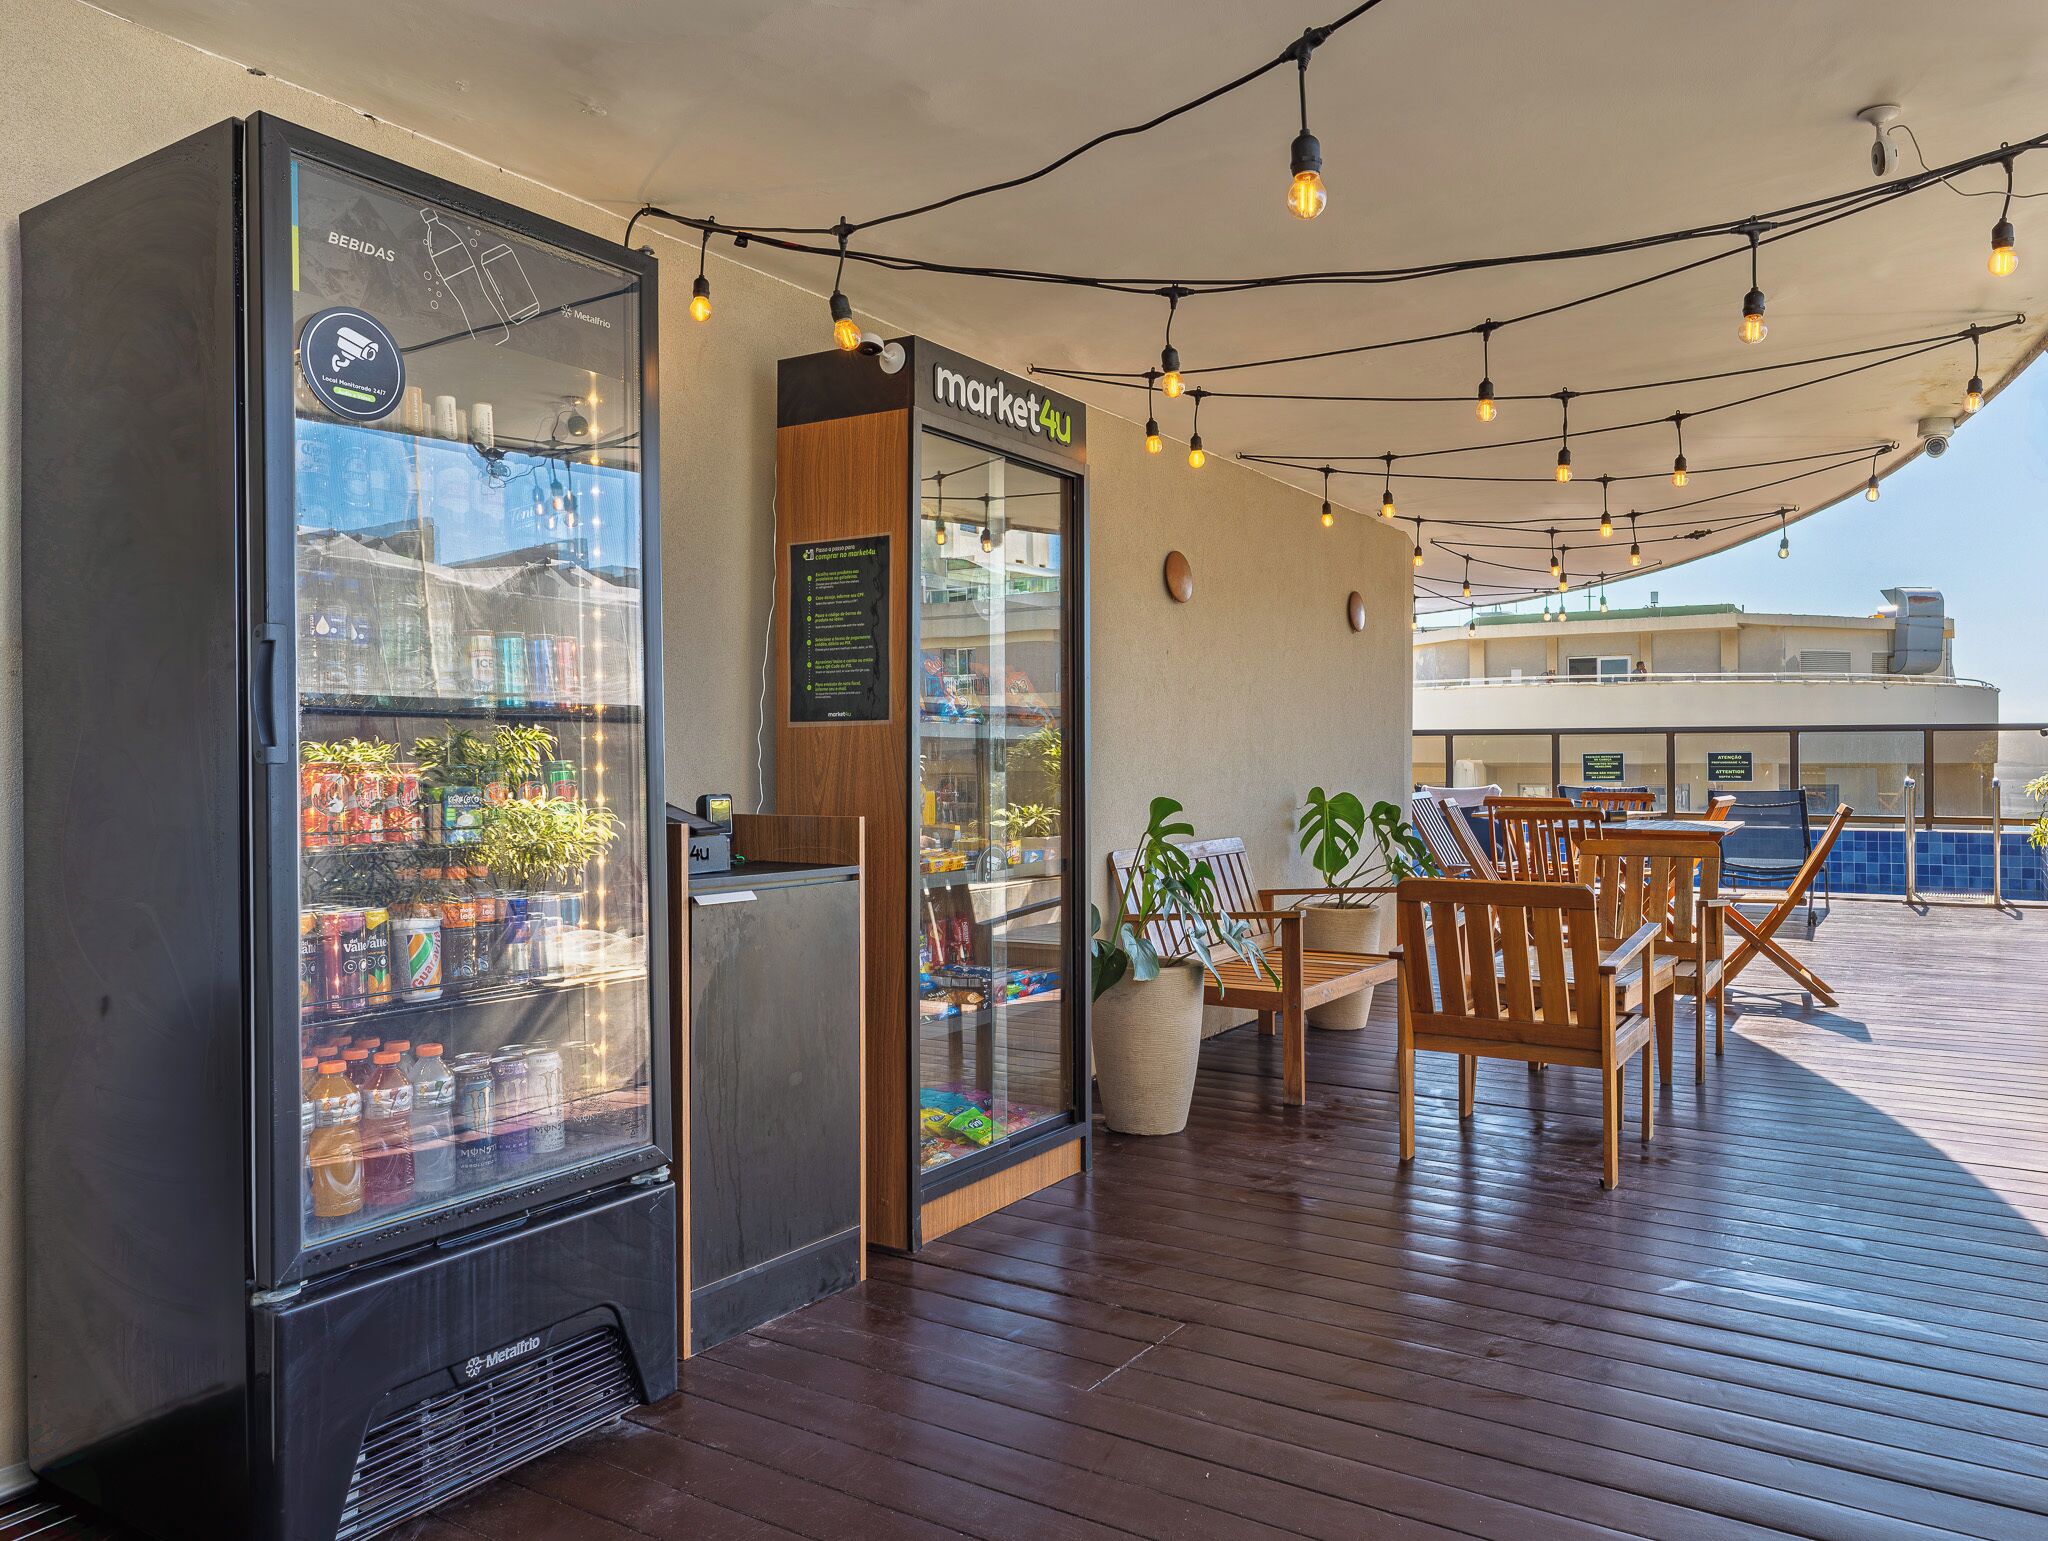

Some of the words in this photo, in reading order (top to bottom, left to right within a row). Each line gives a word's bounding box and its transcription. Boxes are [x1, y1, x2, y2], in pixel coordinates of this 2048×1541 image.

[328, 231, 395, 262] BEBIDAS
[574, 310, 611, 329] Metalfrio
[322, 375, 338, 384] Local
[339, 379, 372, 392] Monitorado
[373, 388, 386, 396] 24/7
[937, 366, 1071, 444] market4u
[689, 845, 710, 862] 4u
[343, 941, 367, 953] Valle
[969, 1119, 983, 1129] Fini
[485, 1335, 541, 1369] Metalfrio
